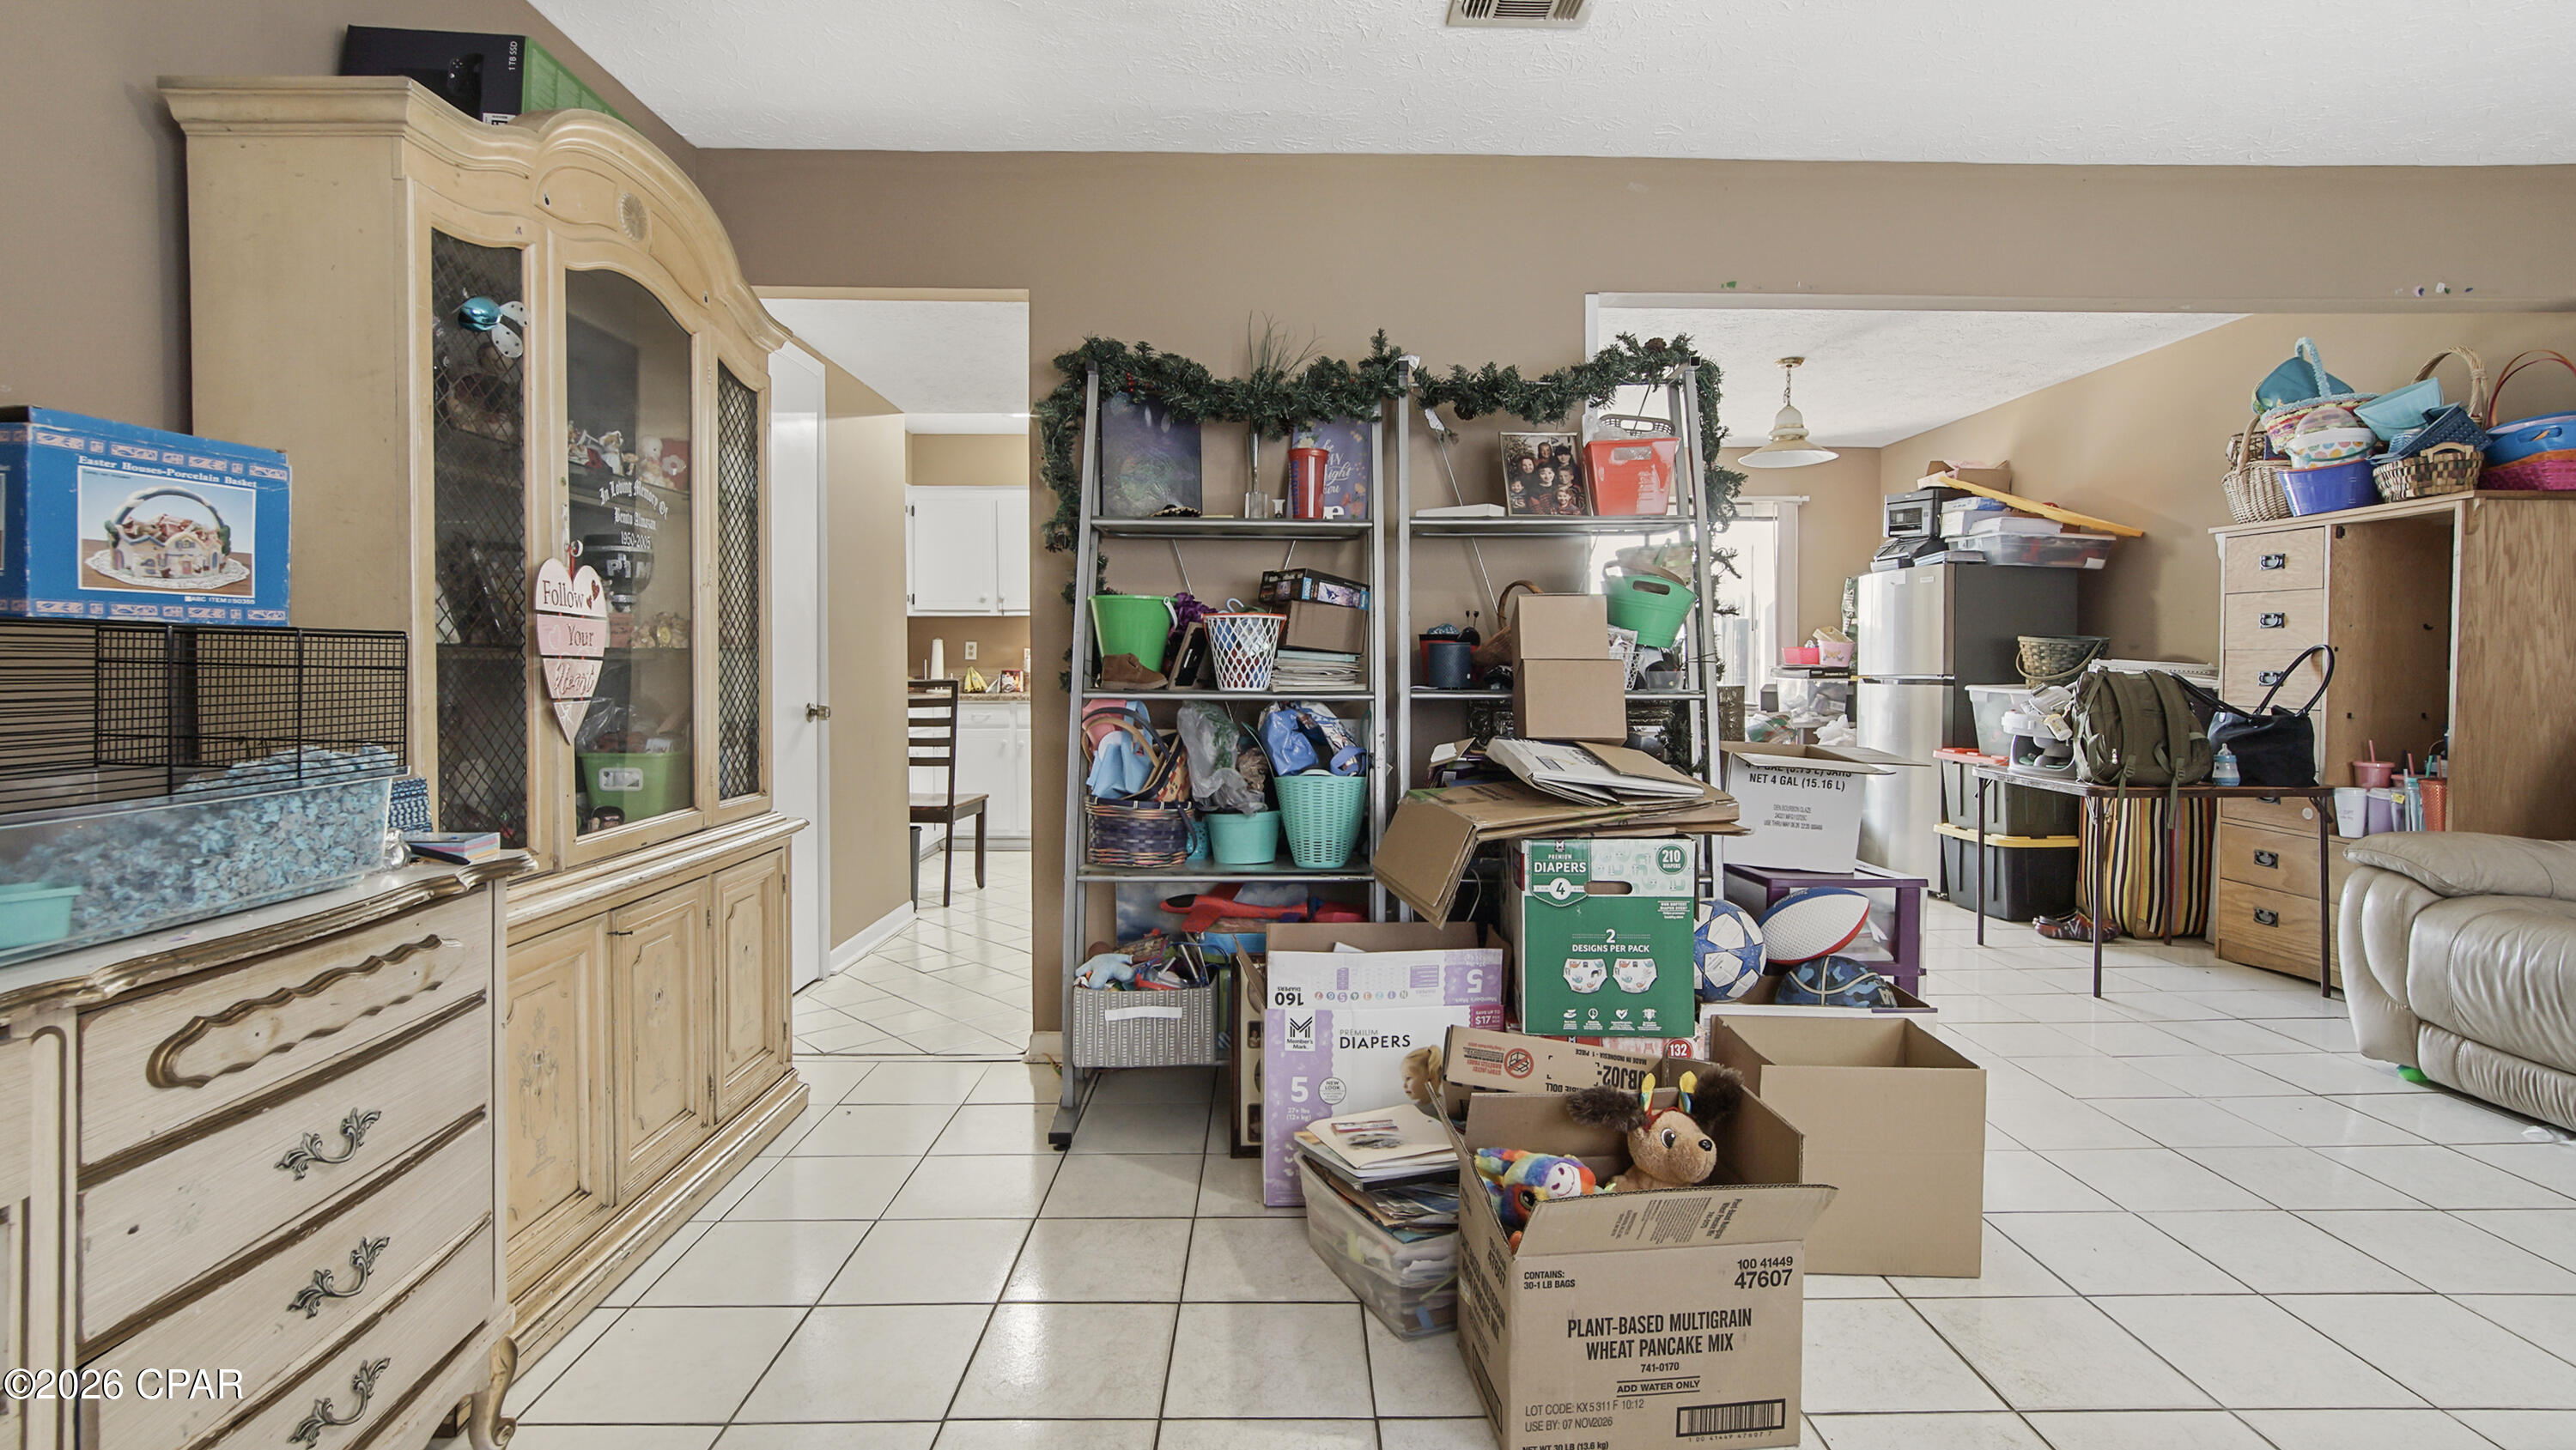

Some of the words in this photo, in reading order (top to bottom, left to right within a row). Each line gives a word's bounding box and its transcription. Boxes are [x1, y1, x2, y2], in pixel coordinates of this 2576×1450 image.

[509, 41, 518, 55] SSD
[508, 56, 517, 65] TB
[78, 455, 117, 469] Easter
[224, 476, 257, 488] Basket
[609, 481, 633, 497] Loving
[633, 479, 658, 510] Memory
[543, 579, 584, 608] Follow
[567, 622, 594, 646] Your
[554, 662, 595, 695] Heart
[1749, 773, 1768, 784] NET
[1771, 775, 1777, 785] 4
[1779, 775, 1799, 786] GAL
[1801, 777, 1832, 789] (15.16
[1836, 780, 1845, 792] L)
[1662, 849, 1681, 863] 210
[1534, 862, 1587, 873] DIAPERS
[1556, 882, 1565, 895] 4
[1606, 928, 1616, 943] 2
[1572, 944, 1607, 953] DESIGNS
[1628, 944, 1649, 953] PACK
[1467, 968, 1484, 993] 5
[1274, 992, 1304, 1006] 160
[1475, 1016, 1492, 1025] $17
[1340, 1034, 1411, 1049] DIAPERS
[1669, 1043, 1688, 1057] 132
[1600, 1053, 1625, 1063] INDONESIA
[1632, 1057, 1647, 1065] MADE
[1291, 1076, 1309, 1103] 5
[1546, 1083, 1563, 1093] DOLL
[1737, 1259, 1757, 1270] 100
[1760, 1256, 1793, 1268] 41449
[1524, 1271, 1564, 1280] CONTAINS:
[1734, 1268, 1793, 1289] 47607
[1524, 1281, 1540, 1289] 30-1
[1542, 1280, 1552, 1289] LB
[1554, 1279, 1576, 1289] BAGS
[1567, 1314, 1664, 1338] PLANT-BASED
[1669, 1307, 1753, 1332] MULTIGRAIN
[1586, 1339, 1634, 1361] WHEAT
[1639, 1336, 1703, 1357] PANCAKE
[1708, 1333, 1735, 1353] MIX
[1640, 1362, 1680, 1374] 741-0170
[1617, 1384, 1637, 1393] ADD
[1640, 1382, 1674, 1392] WATER
[1675, 1380, 1701, 1390] ONLY
[1525, 1404, 1543, 1417] LOT
[1546, 1403, 1574, 1415] CODE:
[1613, 1399, 1619, 1410] F
[1622, 1398, 1644, 1410] 10:12
[1525, 1421, 1544, 1432] USE
[1546, 1420, 1560, 1431] BY:
[1562, 1419, 1572, 1429] 07
[1577, 1441, 1595, 1450] (13.6
[1597, 1441, 1609, 1450] kg)
